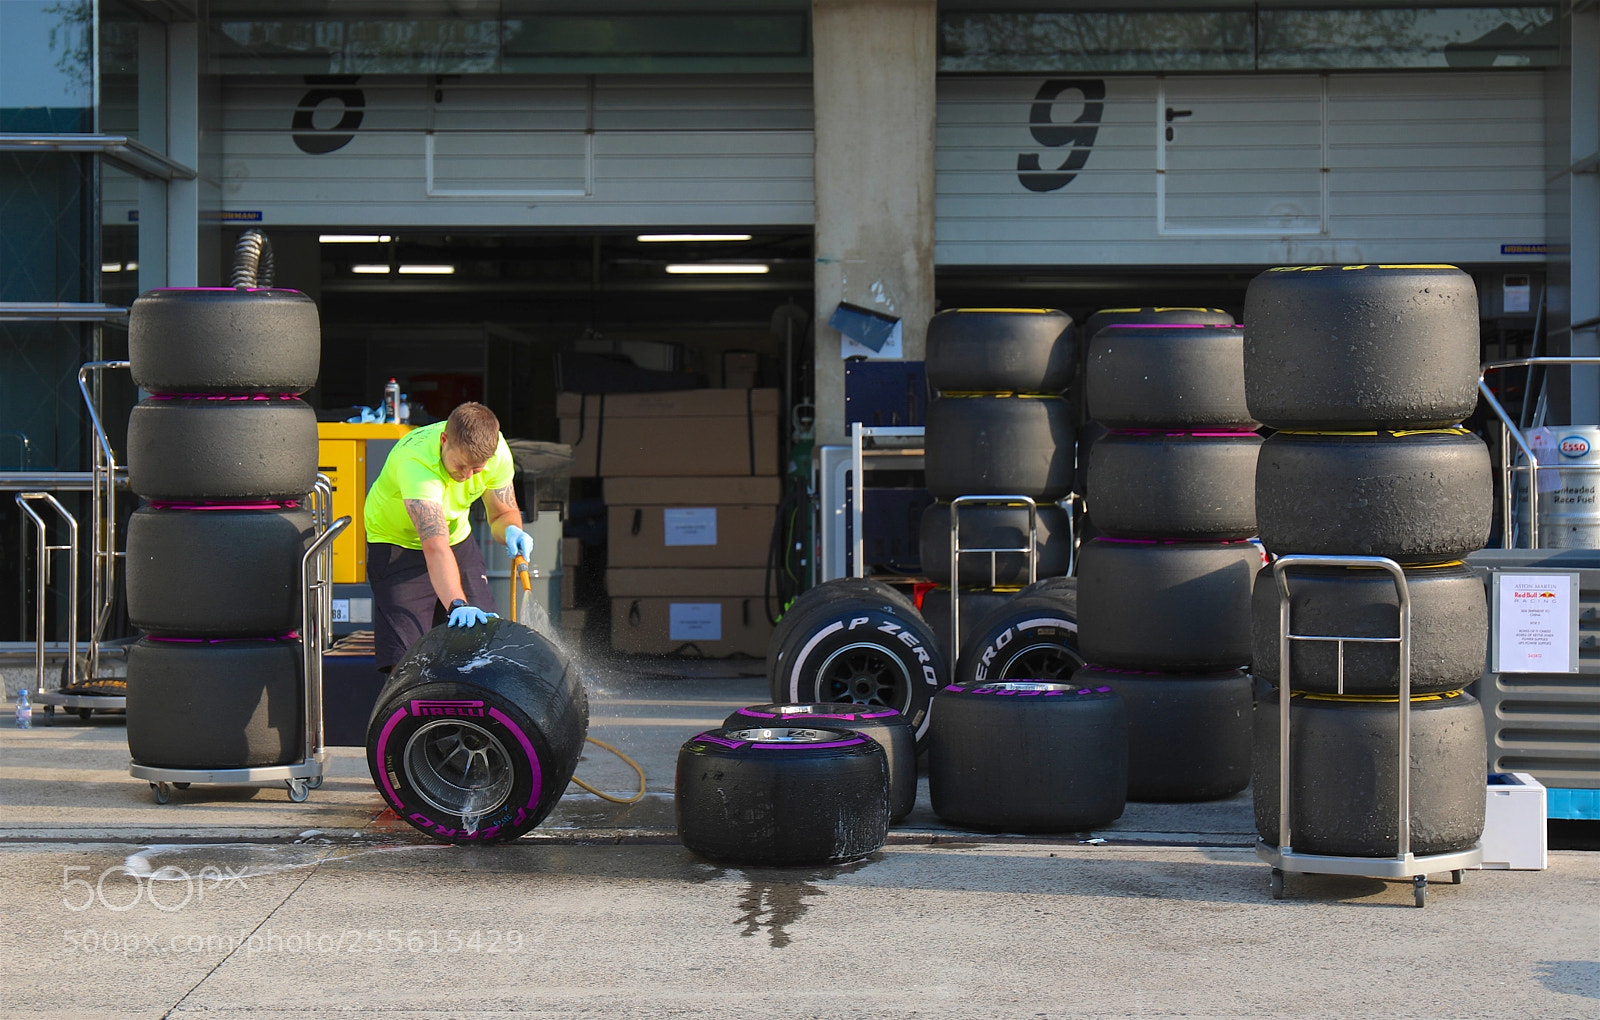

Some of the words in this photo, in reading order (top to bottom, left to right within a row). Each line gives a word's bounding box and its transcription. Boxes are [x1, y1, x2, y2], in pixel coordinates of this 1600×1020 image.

[1017, 79, 1106, 192] 9
[848, 616, 869, 630] P
[877, 620, 938, 686] ZERO
[975, 628, 1013, 681] ERO
[410, 700, 485, 718] PIRELLI
[408, 812, 502, 840] ZERO
[513, 807, 527, 827] P
